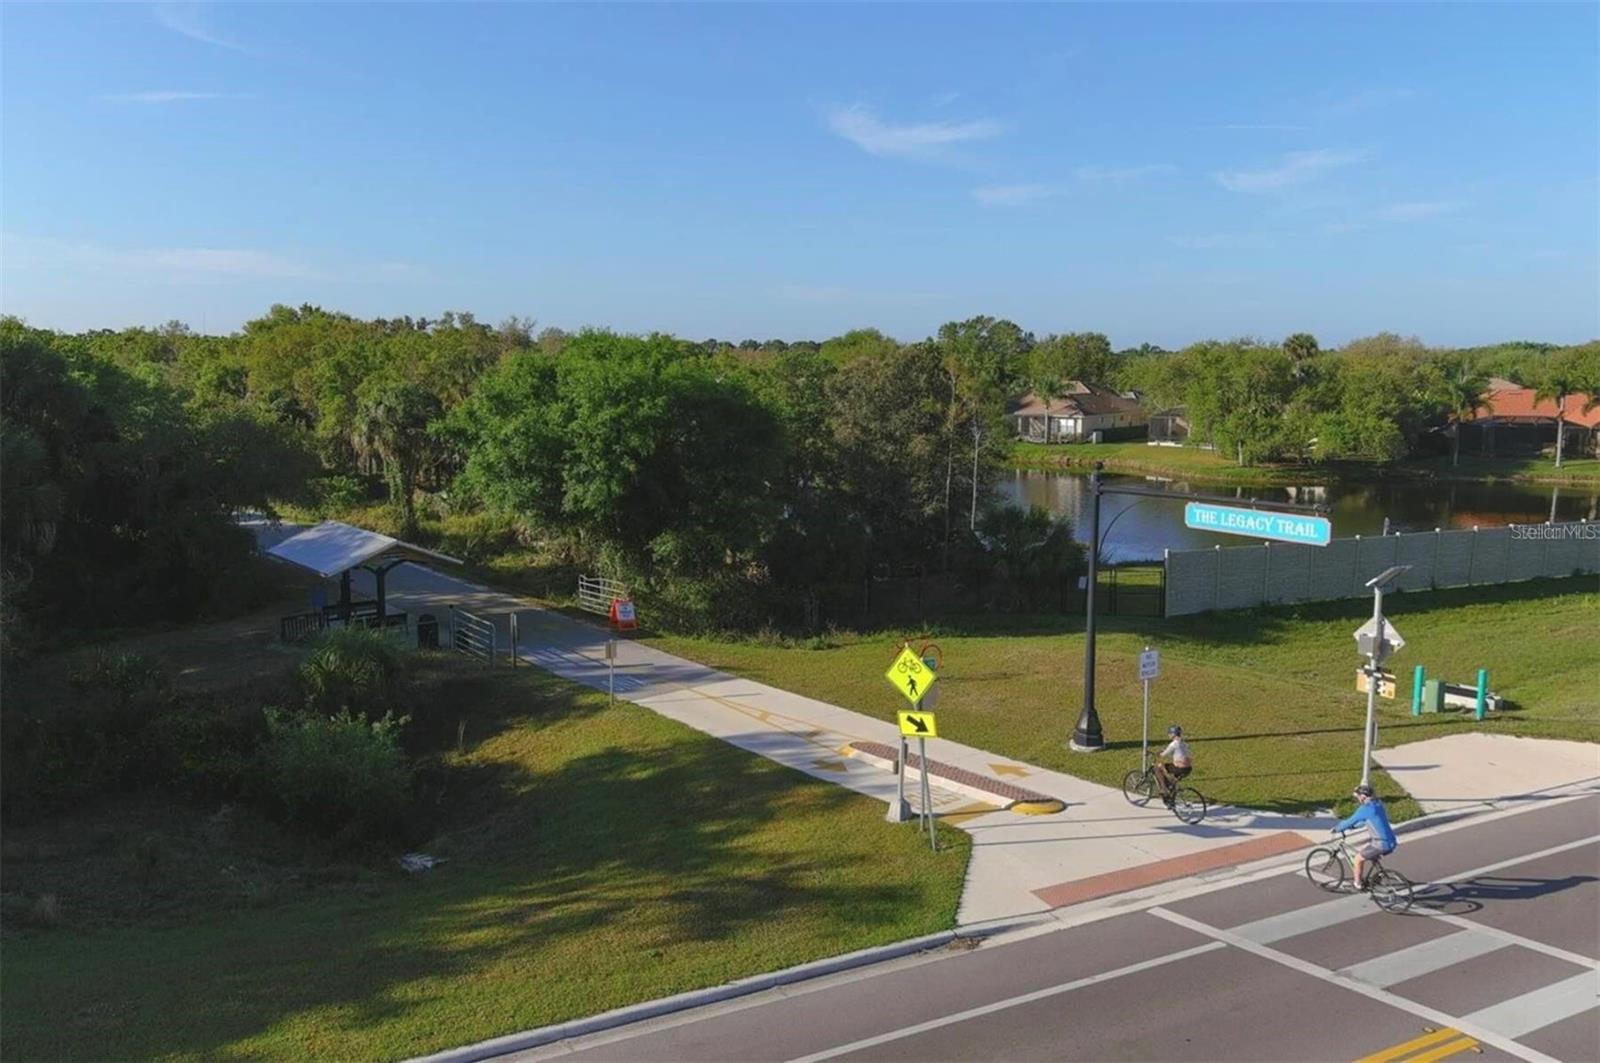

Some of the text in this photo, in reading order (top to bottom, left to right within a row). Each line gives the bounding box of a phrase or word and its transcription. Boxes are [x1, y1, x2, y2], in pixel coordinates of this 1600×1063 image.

[1194, 508, 1318, 538] THE LEGACY TRAIL
